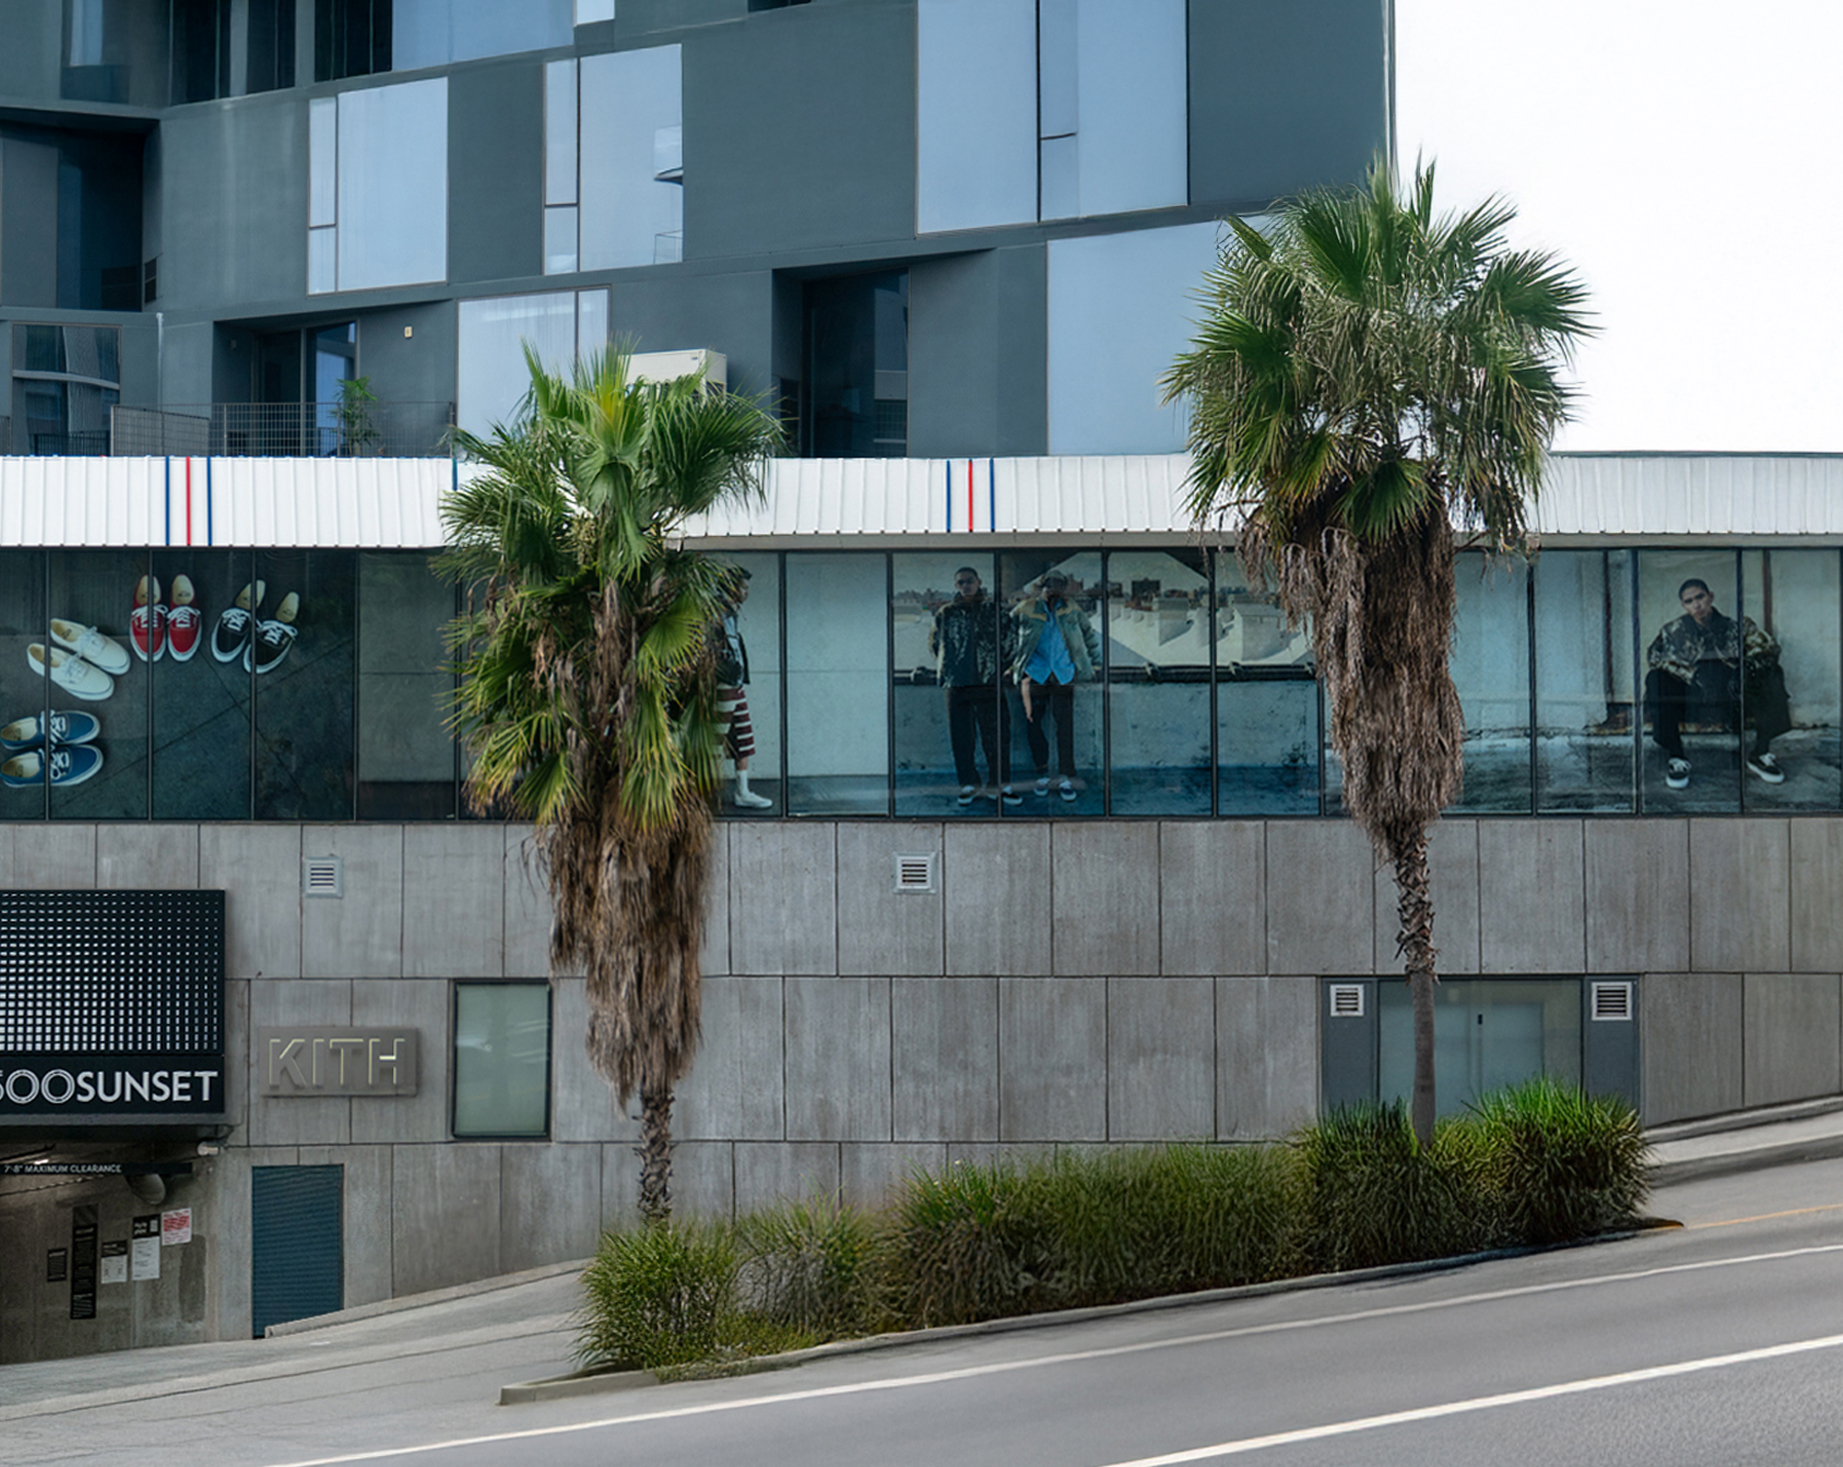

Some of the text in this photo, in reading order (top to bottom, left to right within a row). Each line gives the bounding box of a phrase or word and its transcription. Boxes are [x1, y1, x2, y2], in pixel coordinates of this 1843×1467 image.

[269, 1038, 405, 1088] KITH
[24, 1164, 69, 1173] MAXIMUM
[70, 1164, 122, 1173] CLEARANCE
